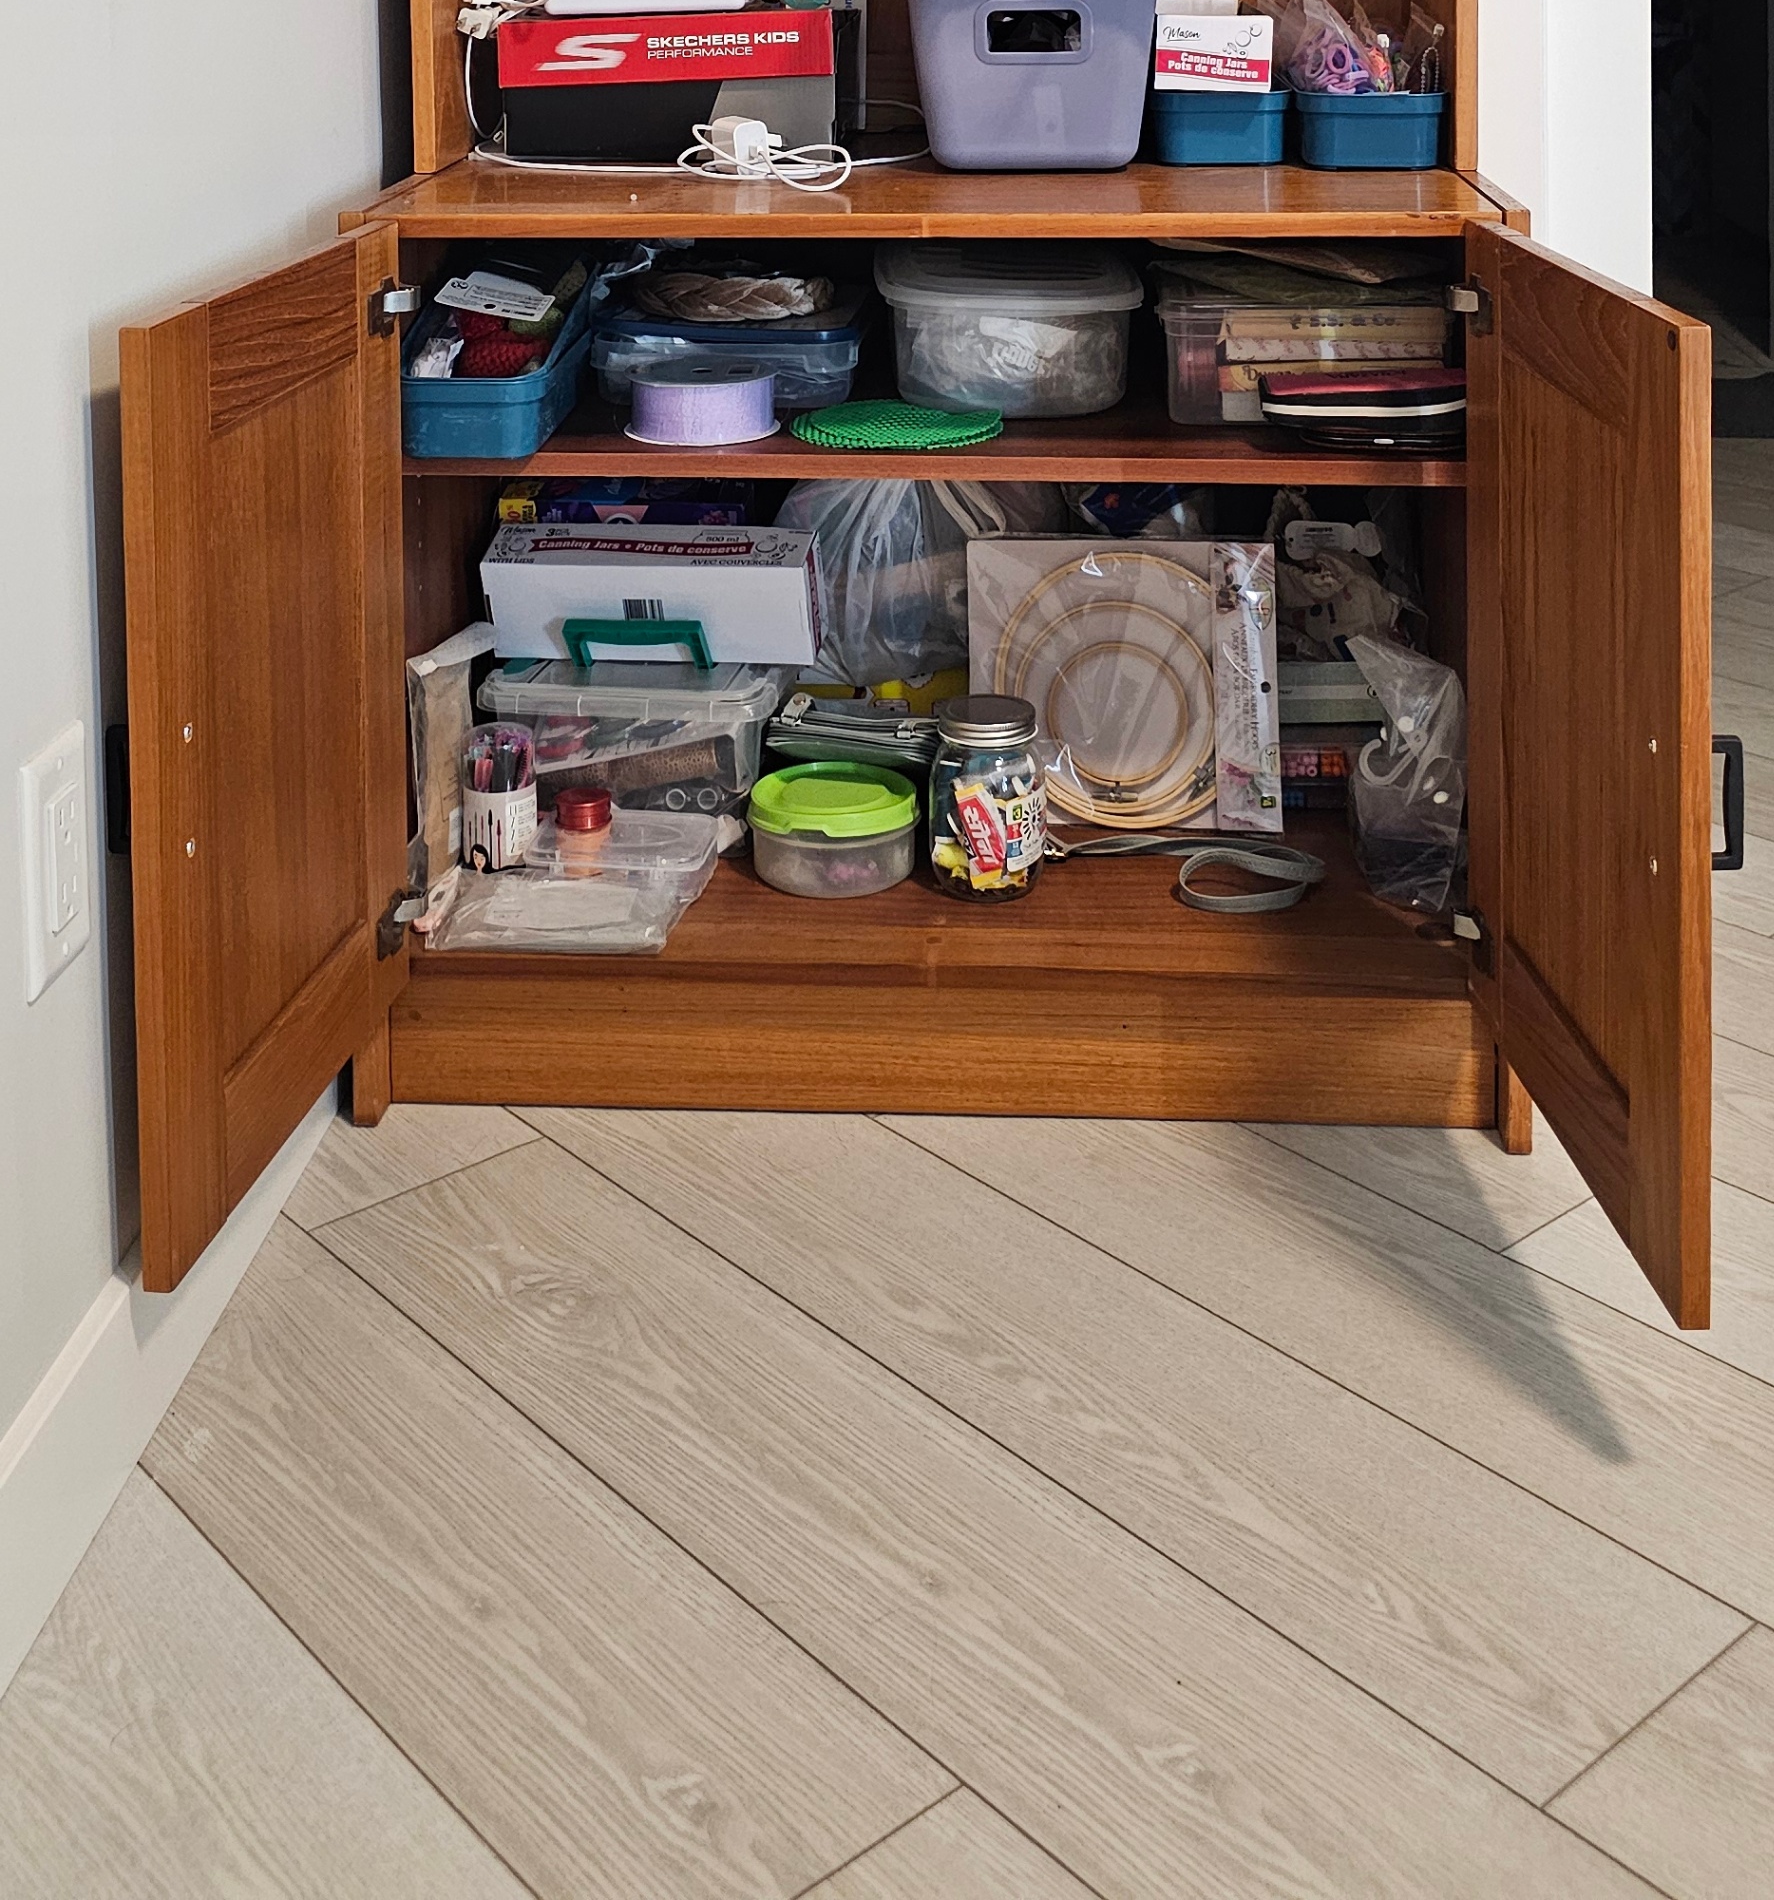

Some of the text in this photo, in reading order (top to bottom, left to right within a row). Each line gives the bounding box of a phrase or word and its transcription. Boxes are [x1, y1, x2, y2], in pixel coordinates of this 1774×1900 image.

[646, 31, 800, 49] SKECHERS KIDS
[1162, 25, 1201, 40] Mason
[647, 46, 753, 60] PERFORMANCE
[1180, 52, 1248, 69] Canning Jars
[1167, 59, 1259, 79] Pots de conserve
[538, 539, 747, 554] Canning Jars Pots de conserve
